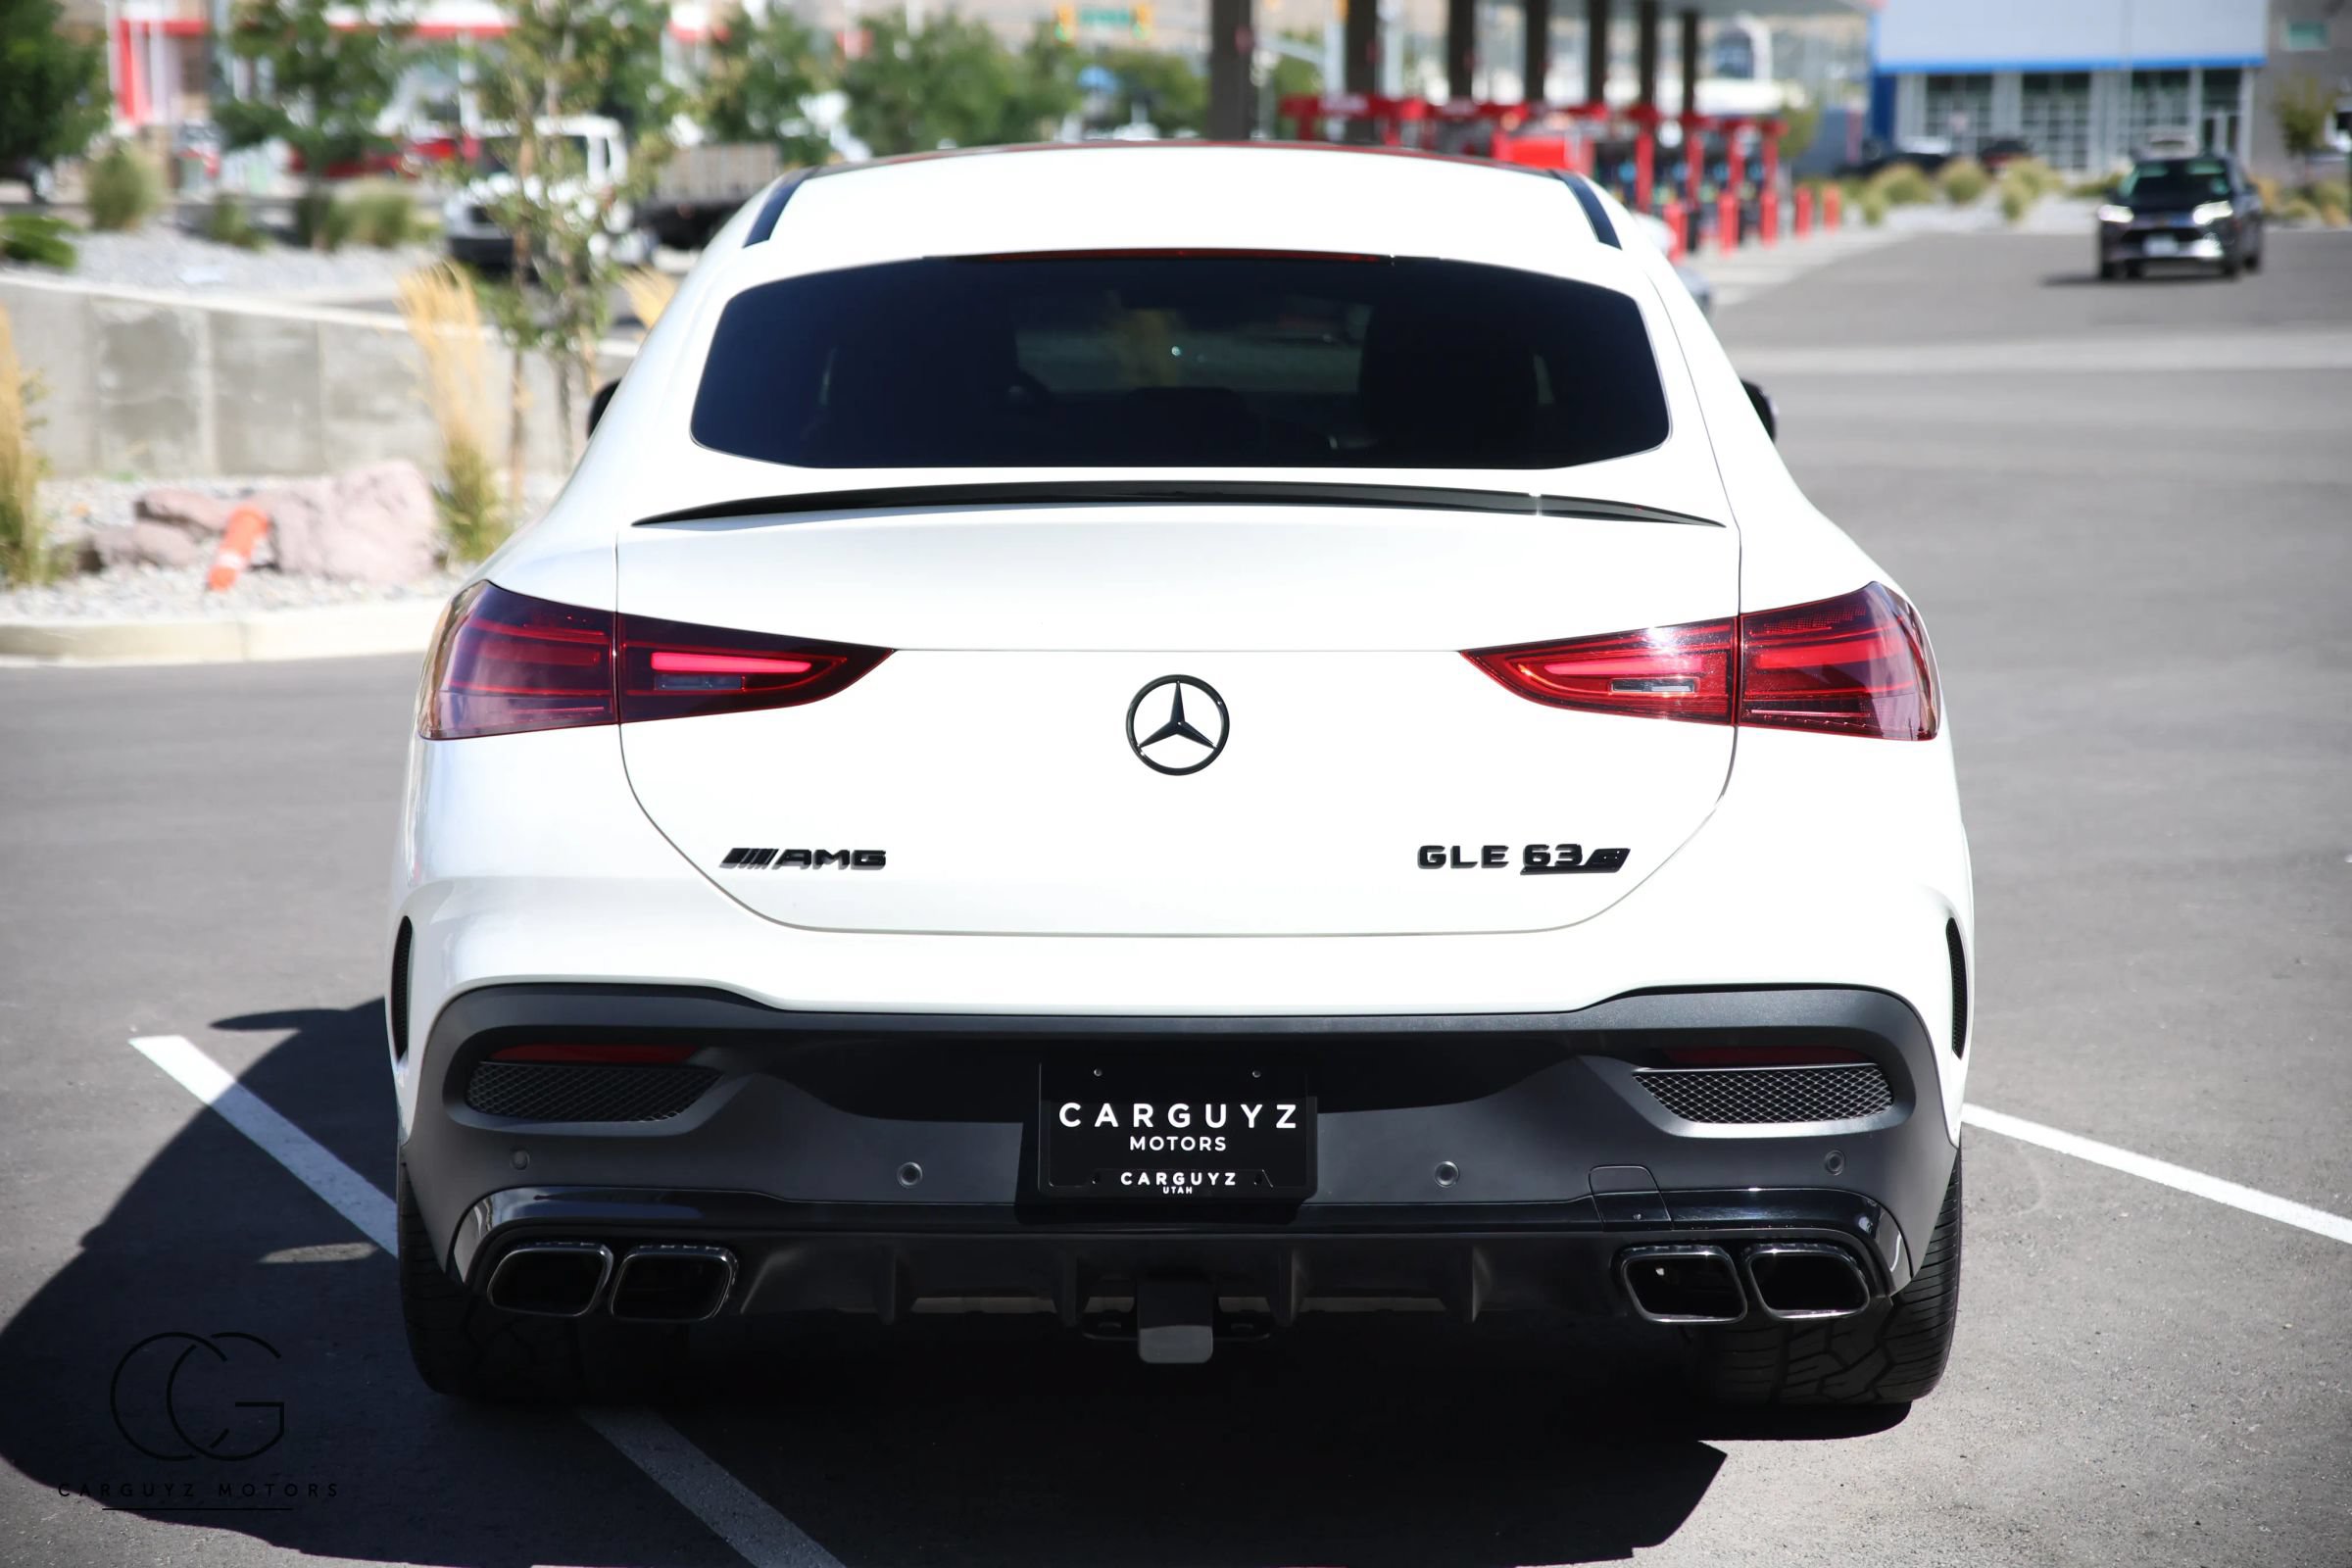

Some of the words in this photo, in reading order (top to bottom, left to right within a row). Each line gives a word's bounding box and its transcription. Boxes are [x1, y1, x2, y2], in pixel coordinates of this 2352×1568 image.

[771, 849, 886, 870] AMG
[1417, 845, 1510, 869] GLE
[1058, 1102, 1297, 1129] CARGUYZ
[1129, 1135, 1227, 1152] MOTORS
[1120, 1172, 1236, 1186] CARGUYZ
[1162, 1186, 1193, 1195] UTAH
